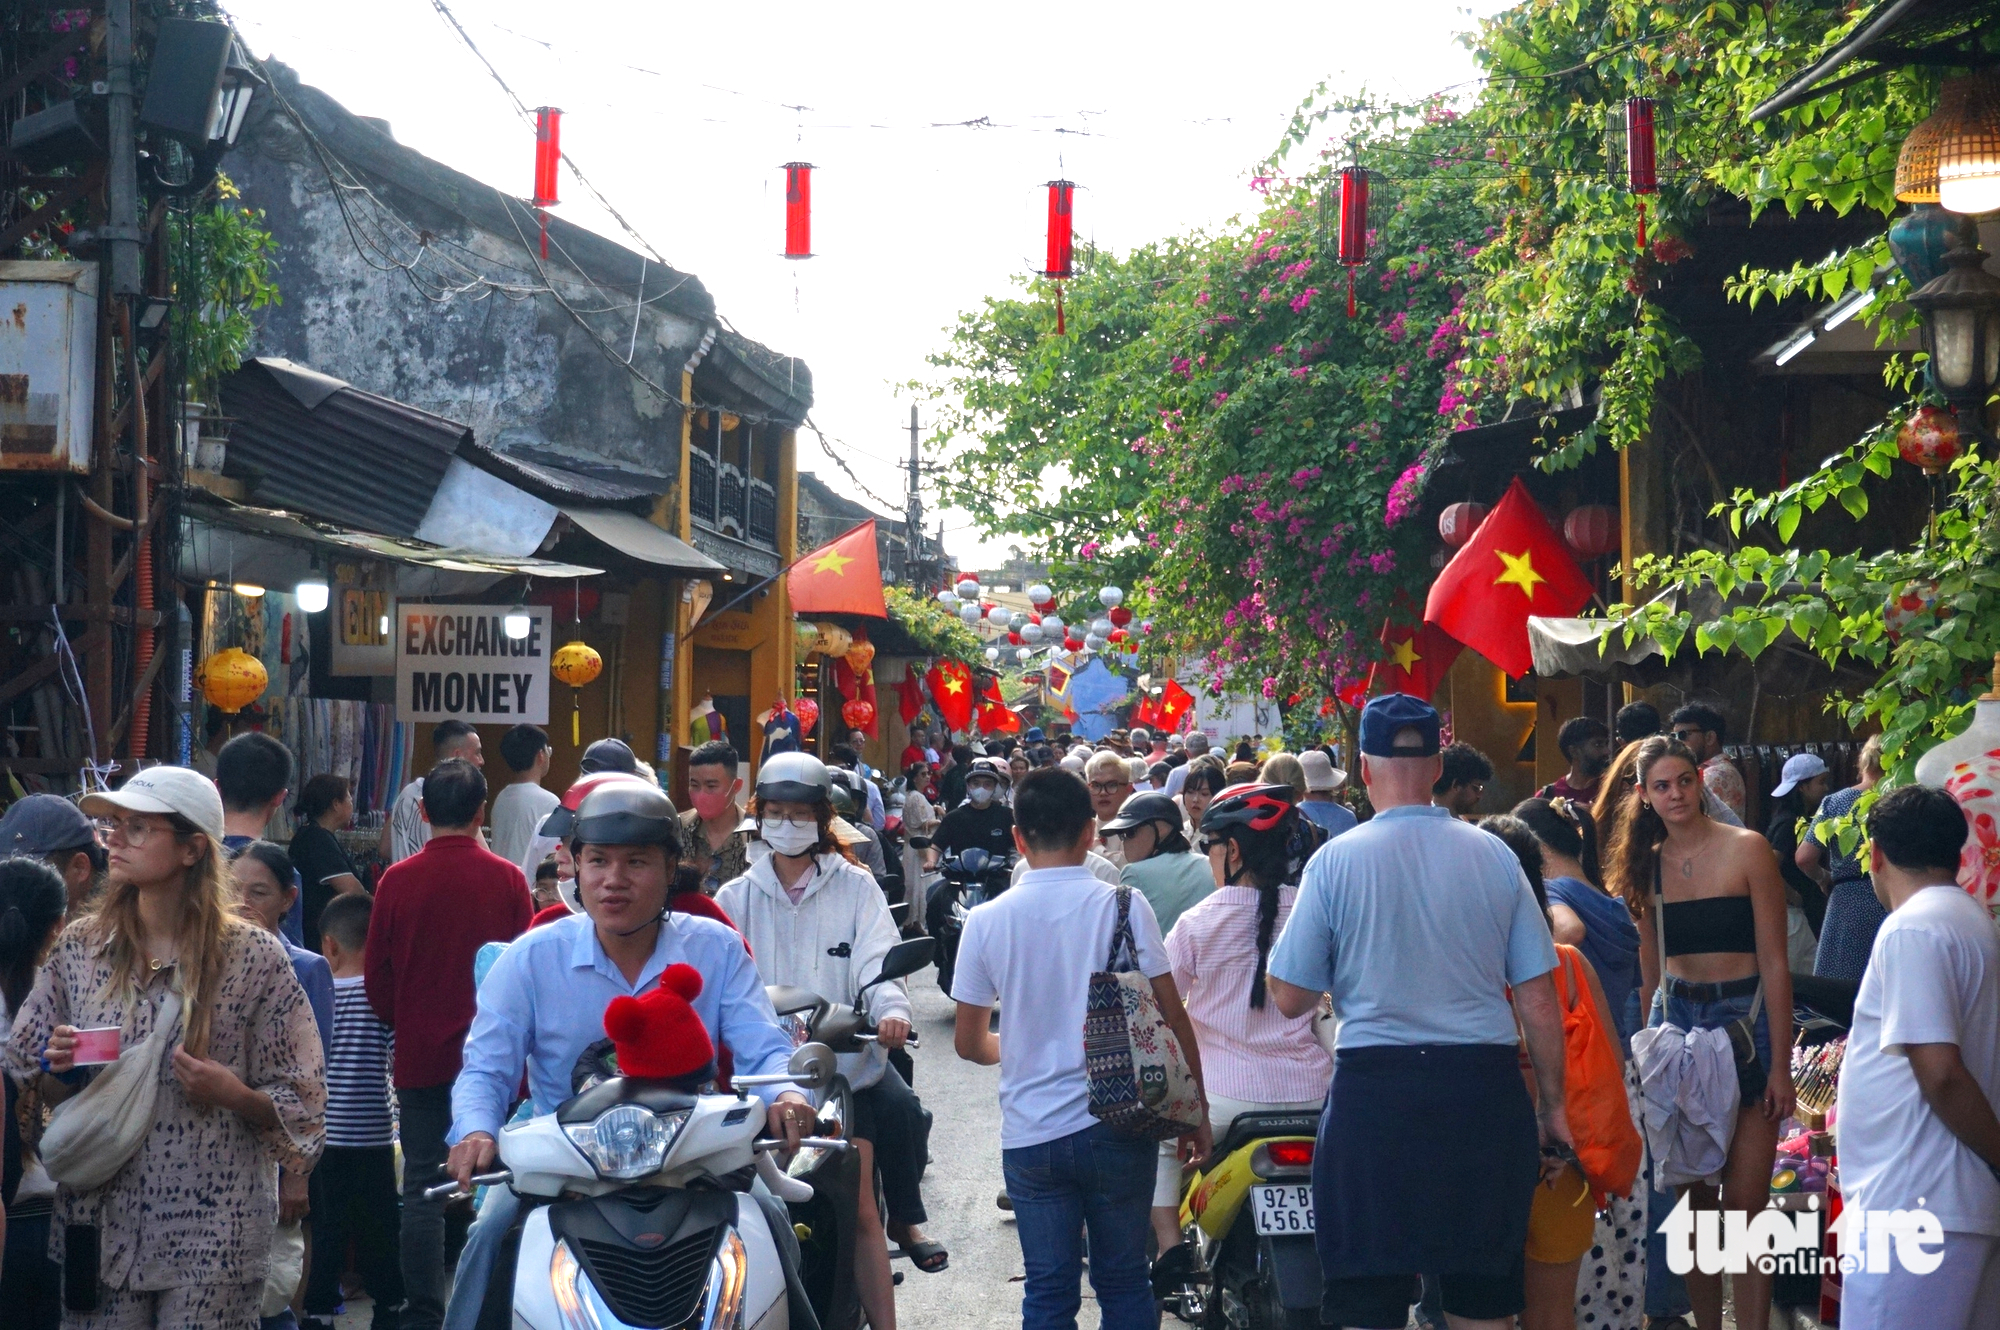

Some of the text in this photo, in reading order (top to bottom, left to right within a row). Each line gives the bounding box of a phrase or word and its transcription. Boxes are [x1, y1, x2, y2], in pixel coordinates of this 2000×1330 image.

[412, 672, 533, 714] MONEY
[1258, 1118, 1310, 1127] SUZUKI
[1263, 1187, 1313, 1209] 92-B
